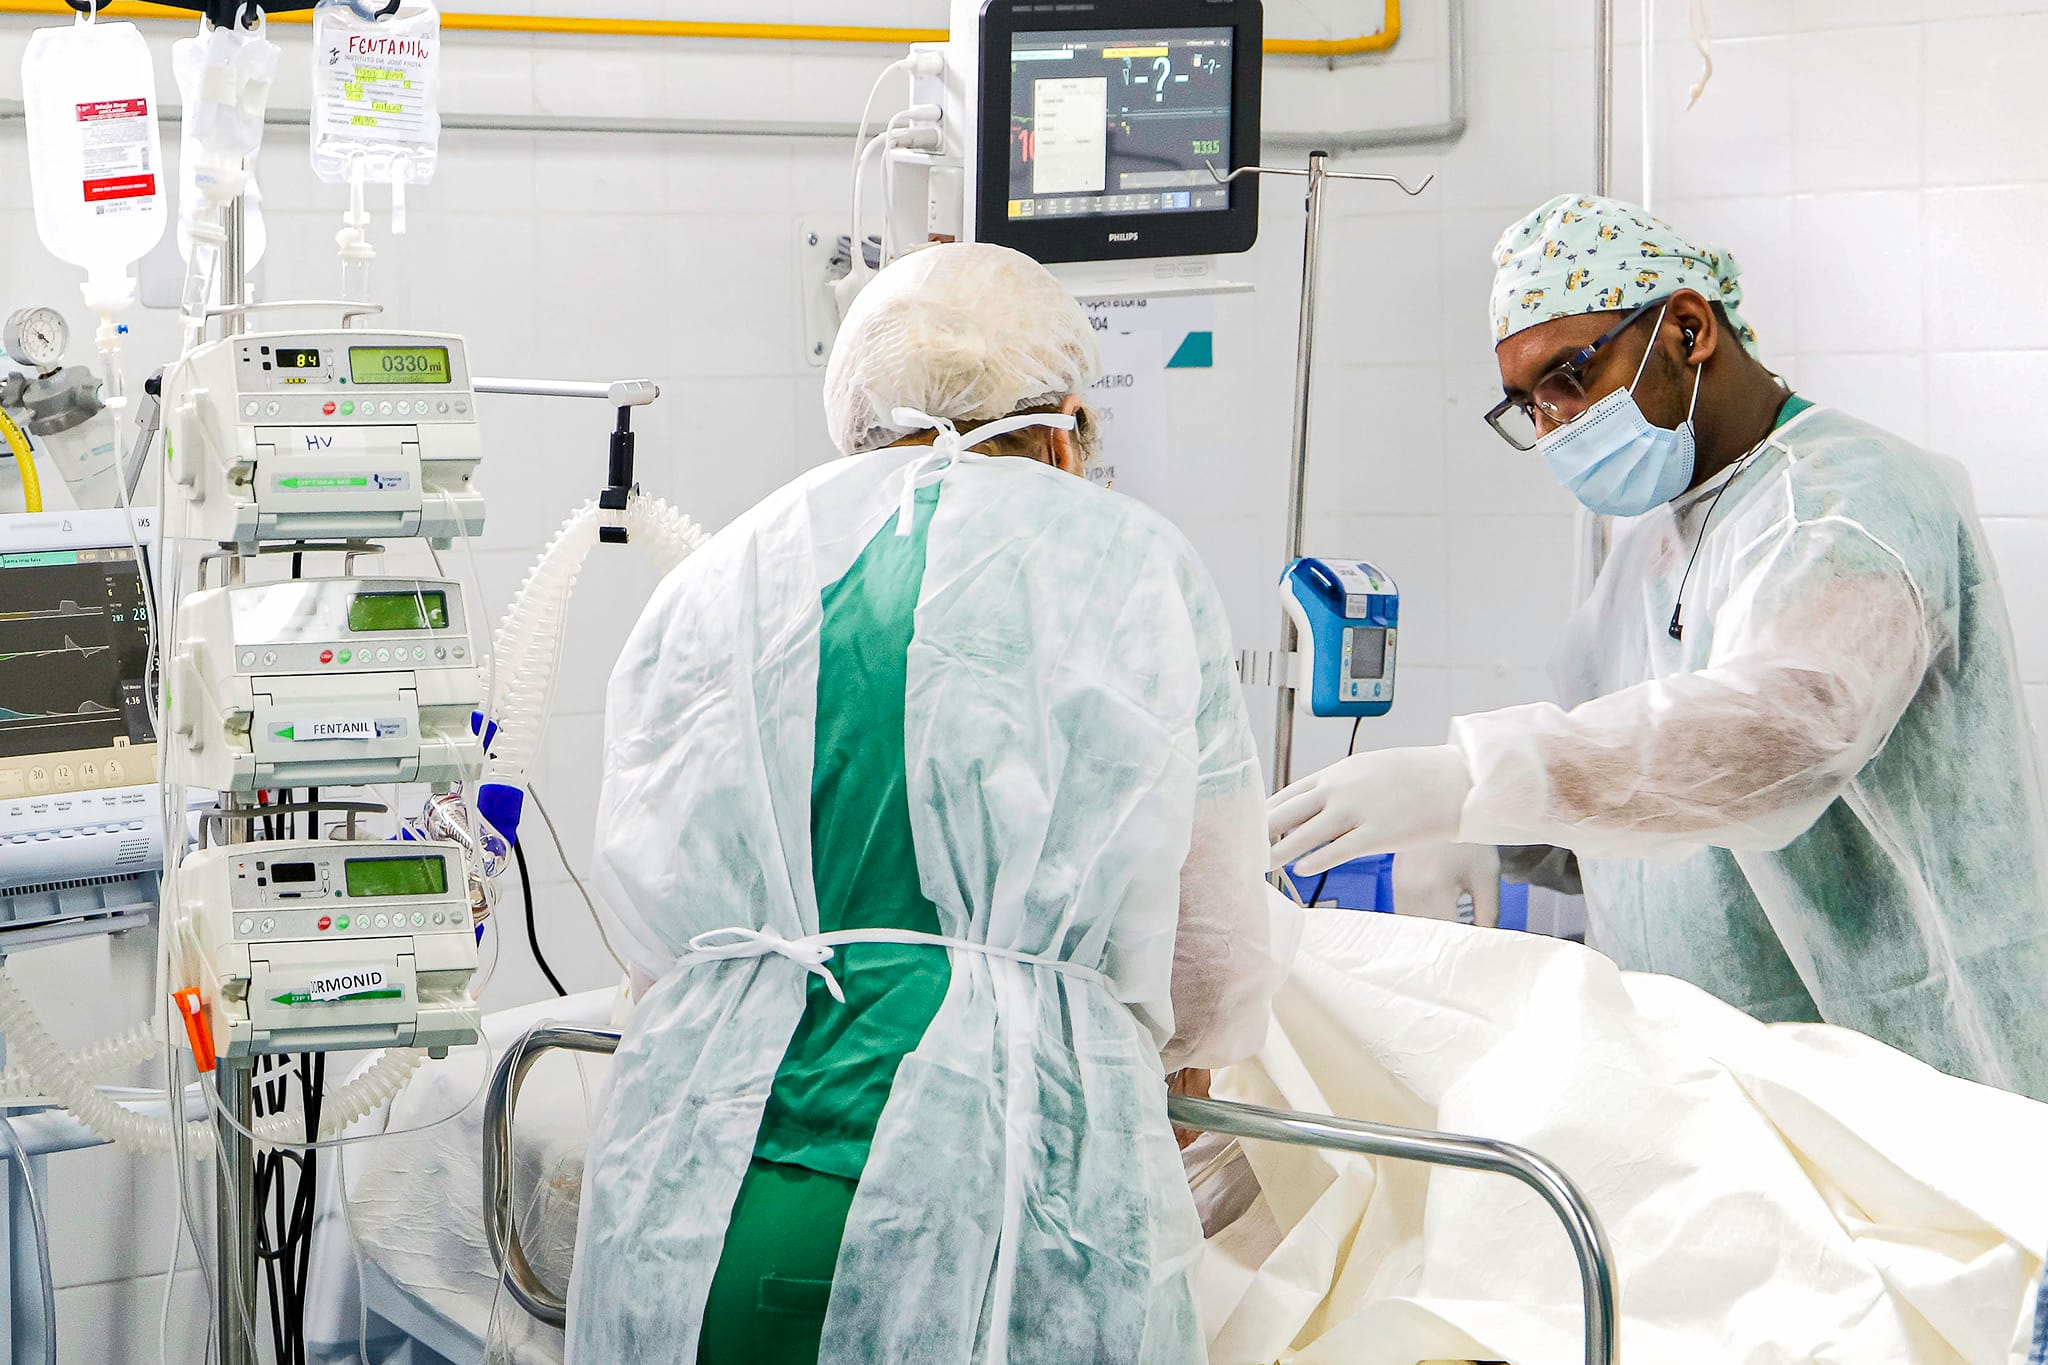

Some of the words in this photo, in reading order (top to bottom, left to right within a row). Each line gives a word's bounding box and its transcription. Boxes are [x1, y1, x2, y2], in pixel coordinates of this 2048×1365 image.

[1108, 232, 1139, 242] PHILIPS
[295, 353, 317, 368] 84
[382, 354, 429, 373] 0330
[305, 434, 333, 451] HV
[313, 722, 370, 735] FENTANIL
[58, 767, 69, 777] 12
[83, 764, 94, 775] 14
[110, 762, 116, 772] 5
[32, 769, 44, 780] 30
